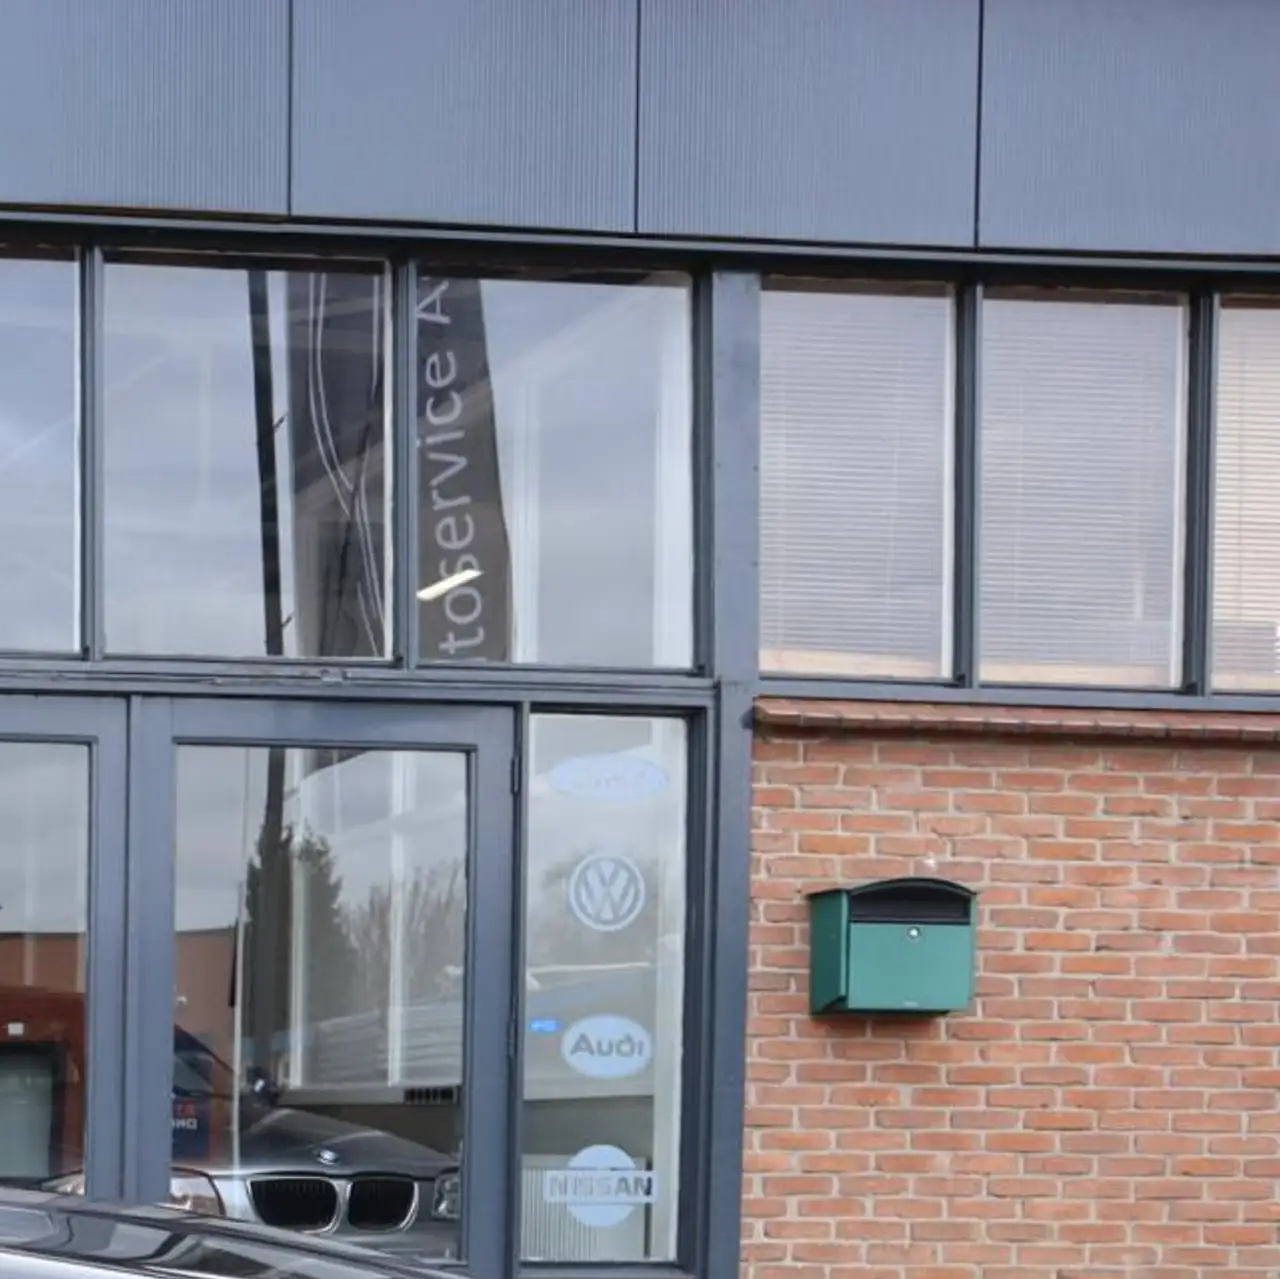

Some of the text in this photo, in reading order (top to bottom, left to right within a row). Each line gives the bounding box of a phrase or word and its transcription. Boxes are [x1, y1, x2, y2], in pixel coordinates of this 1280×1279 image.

[421, 352, 486, 657] toservice
[570, 1032, 644, 1058] Audi
[549, 1176, 653, 1198] NISSAN
